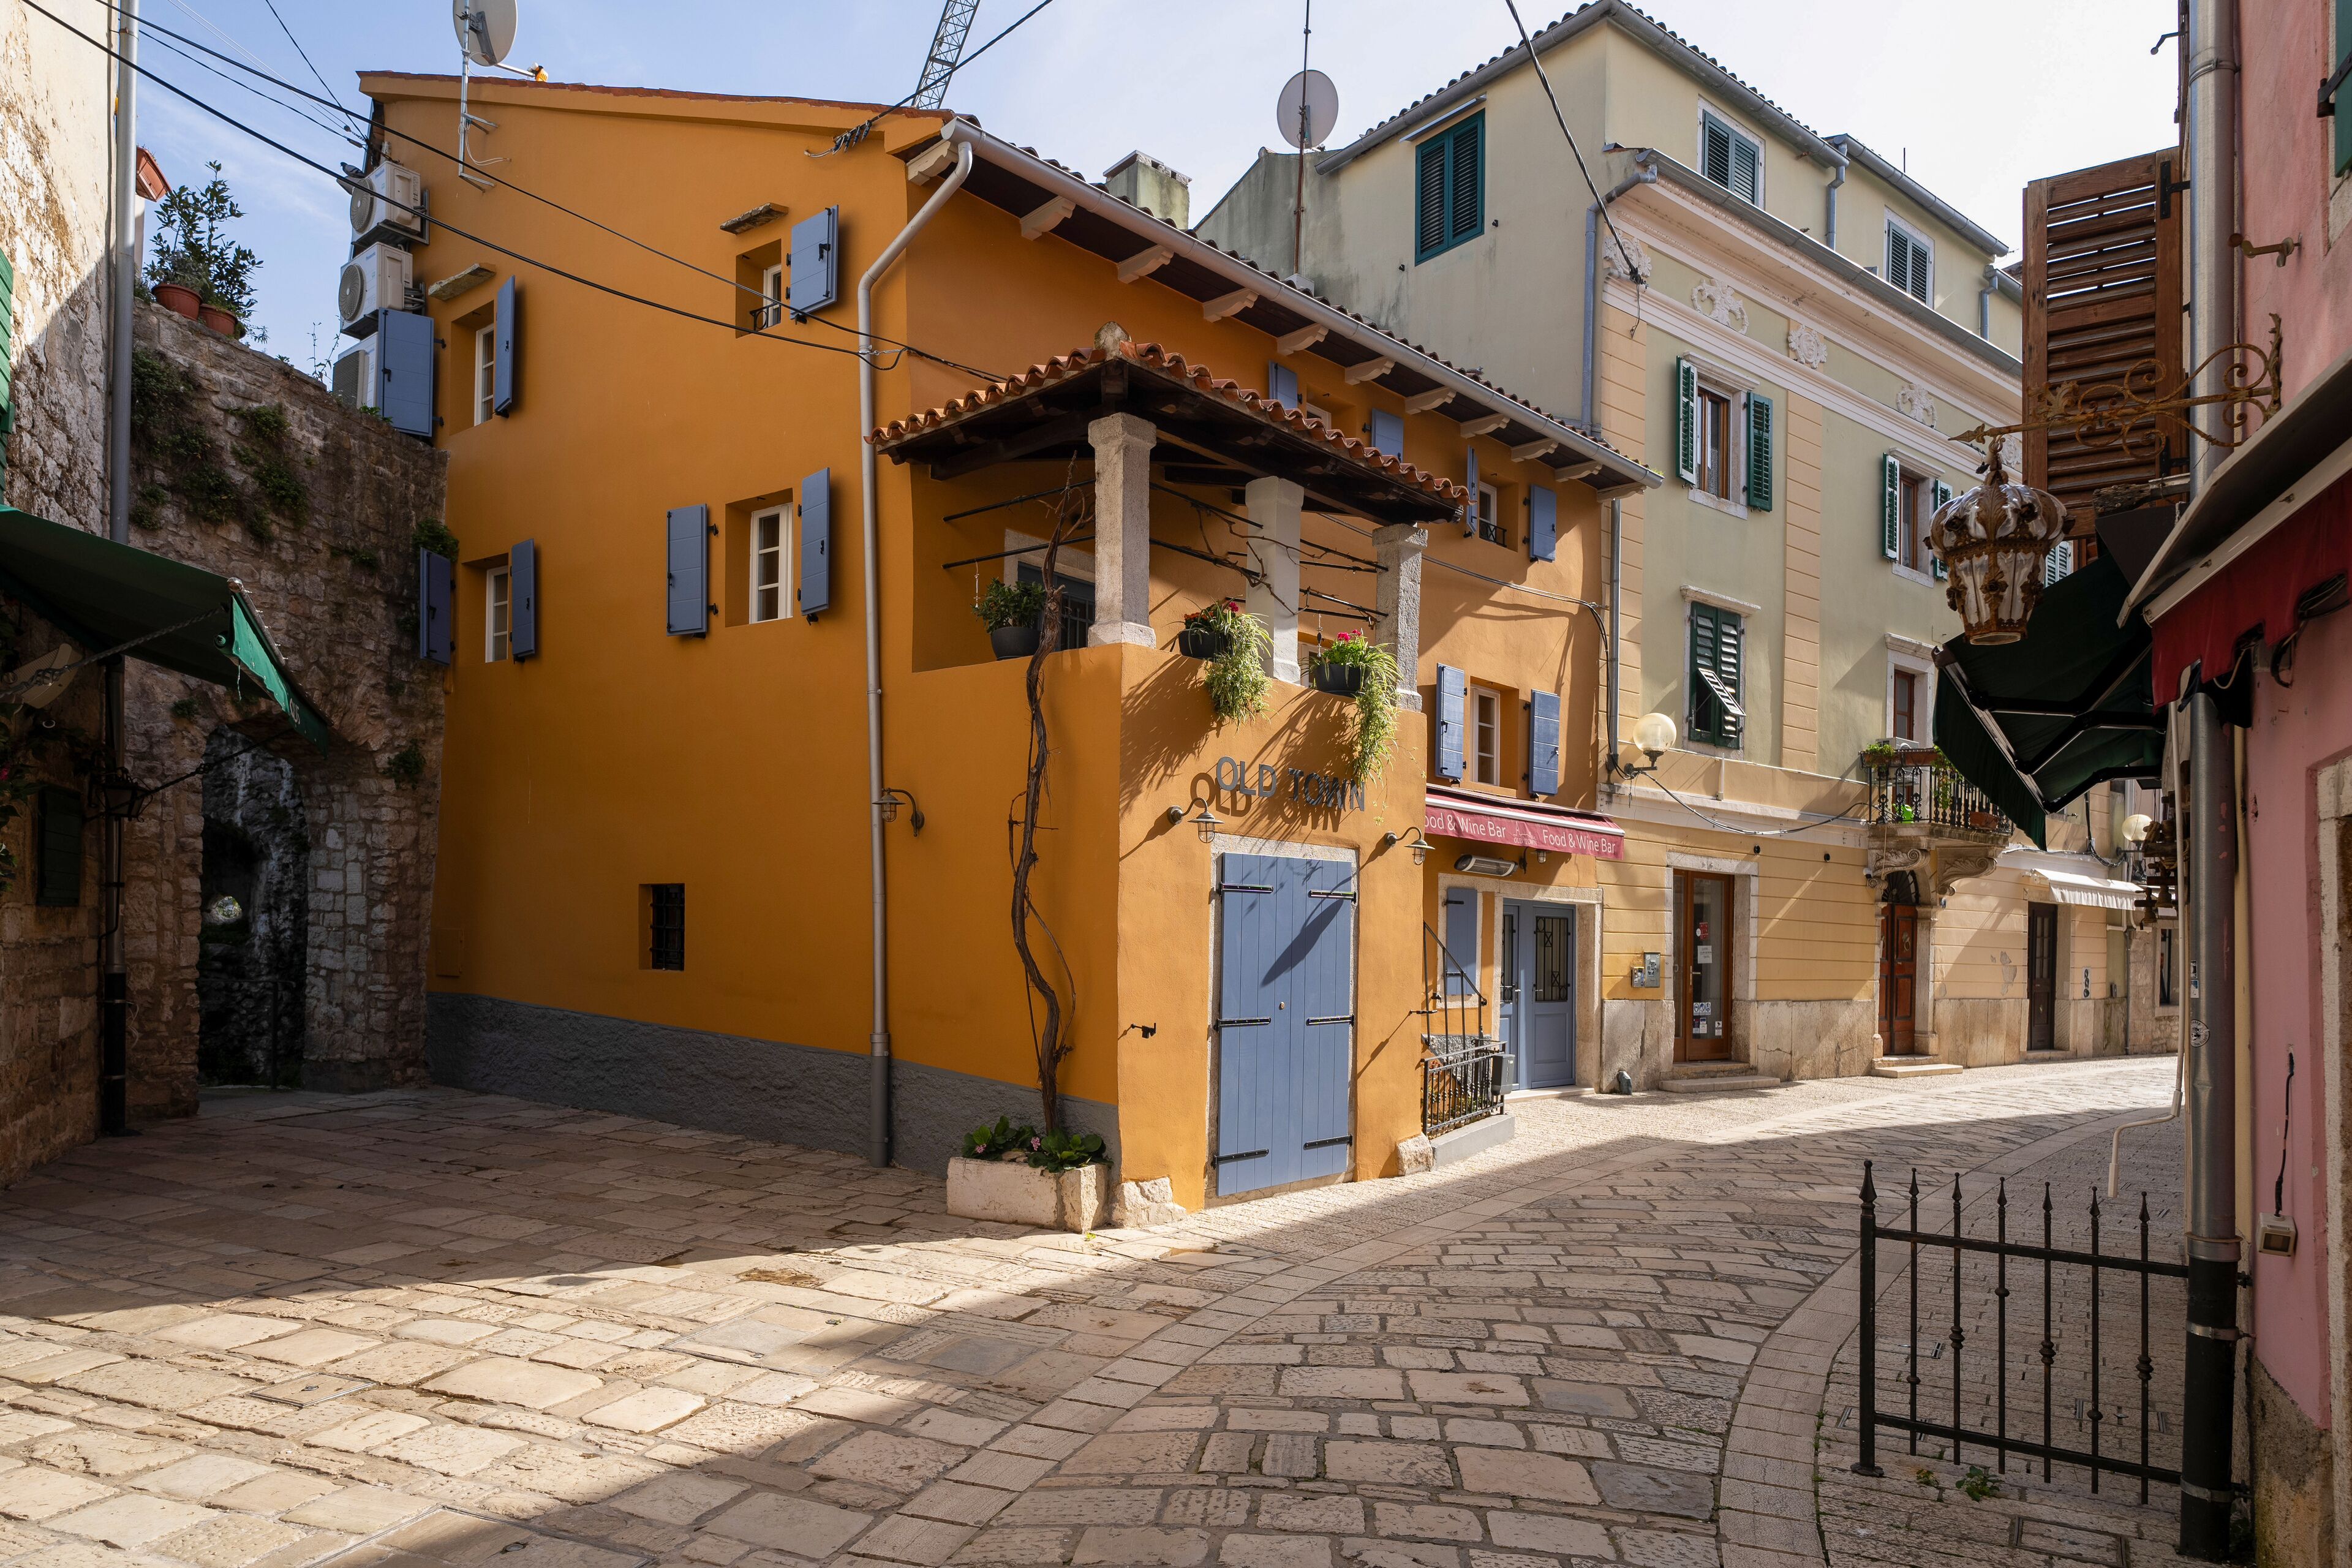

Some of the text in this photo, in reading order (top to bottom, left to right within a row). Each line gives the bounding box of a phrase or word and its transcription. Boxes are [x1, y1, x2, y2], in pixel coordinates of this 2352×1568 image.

[1216, 756, 1365, 812] OLD TOWN
[1447, 814, 1456, 831] &
[1457, 816, 1486, 835] Wine
[1488, 821, 1506, 838] Bar
[1524, 838, 1537, 846] TOWN
[1542, 829, 1616, 854] Food & Wine Bar
